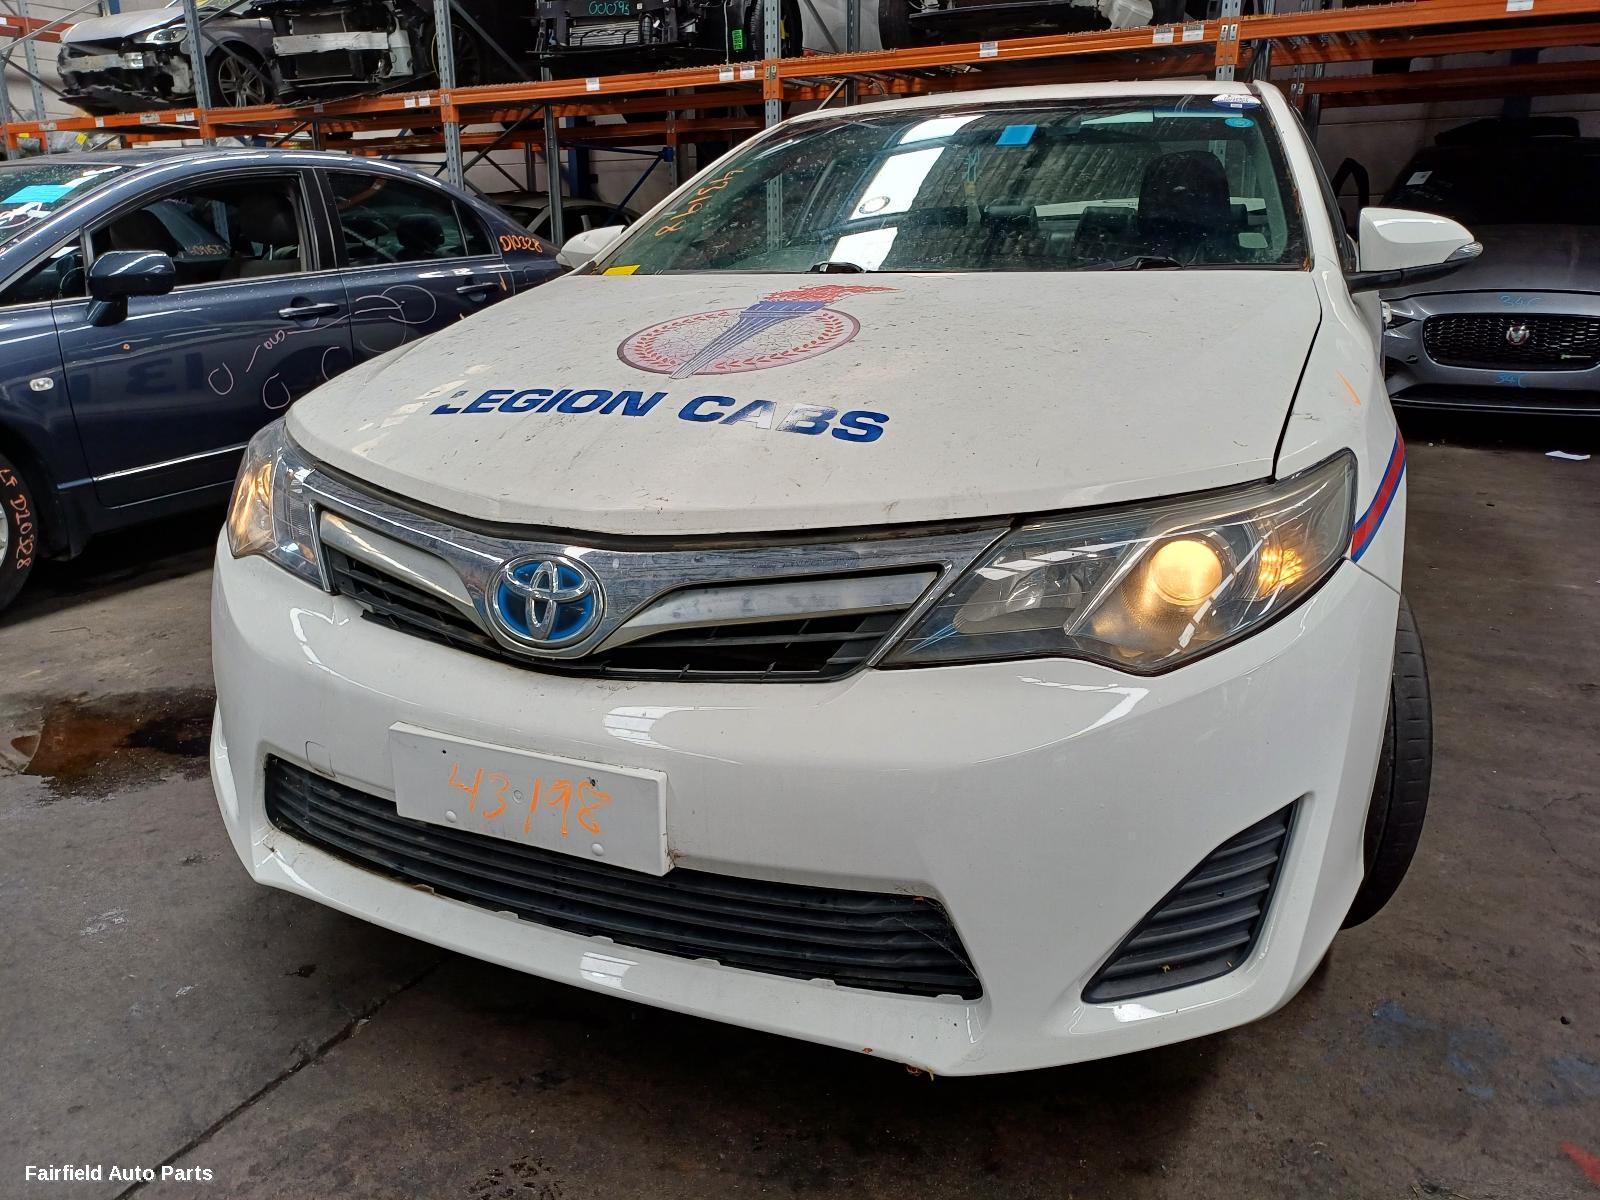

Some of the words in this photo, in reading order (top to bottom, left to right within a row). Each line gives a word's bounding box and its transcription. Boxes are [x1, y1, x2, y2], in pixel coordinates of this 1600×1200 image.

[430, 389, 668, 417] LEGION
[678, 395, 890, 442] CABS
[449, 762, 613, 839] 43198
